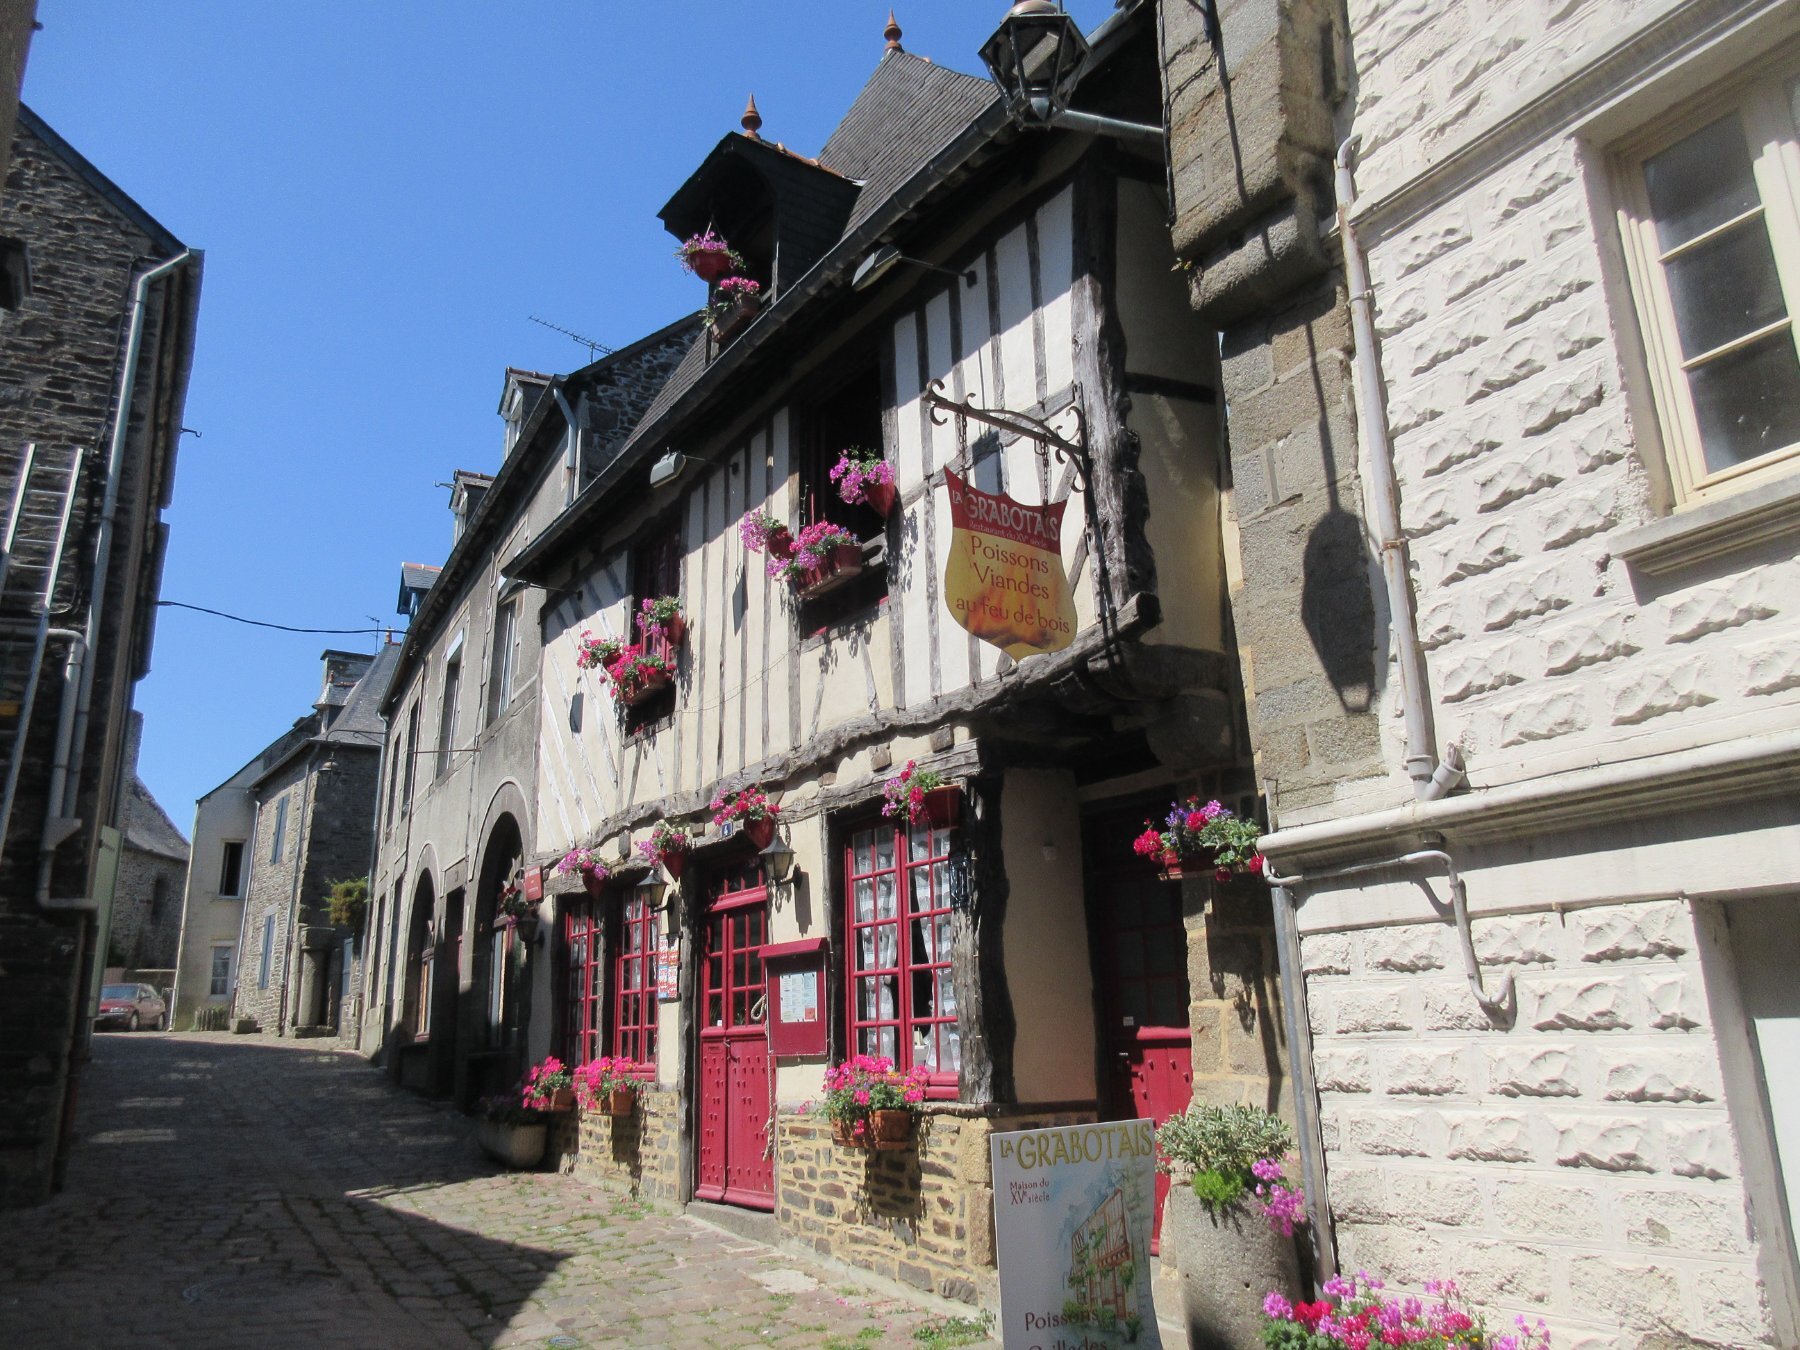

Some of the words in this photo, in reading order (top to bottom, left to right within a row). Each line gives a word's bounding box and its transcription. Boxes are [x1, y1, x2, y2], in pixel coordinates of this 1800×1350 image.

[952, 490, 963, 504] LA
[965, 493, 1060, 541] GRABOTAIS
[970, 535, 1049, 574] Poissons
[971, 561, 1049, 600] Viandes
[956, 597, 977, 613] au
[981, 597, 1009, 620] feu
[1013, 604, 1034, 626] de
[1038, 608, 1070, 634] bois
[1000, 1138, 1015, 1159] LA
[1016, 1122, 1153, 1170] GRABOTAIS
[1009, 1180, 1038, 1191] Maison
[1039, 1177, 1050, 1188] du
[1028, 1190, 1050, 1204] siècle
[1025, 1309, 1099, 1331] Poissons
